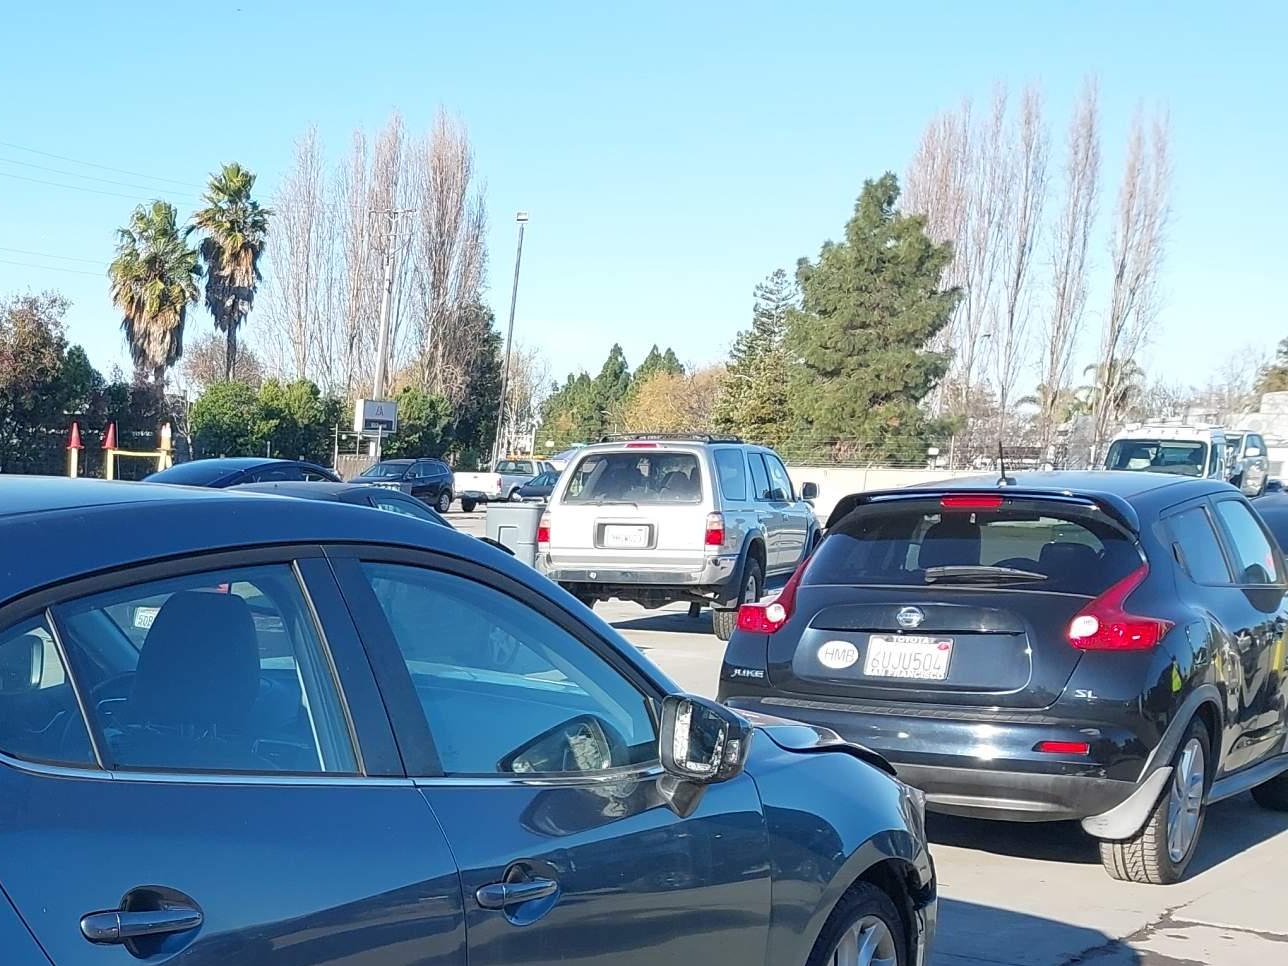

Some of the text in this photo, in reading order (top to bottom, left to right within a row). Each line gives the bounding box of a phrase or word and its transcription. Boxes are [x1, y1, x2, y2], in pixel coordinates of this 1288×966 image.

[824, 647, 855, 663] HMB
[870, 650, 943, 672] 6UJU504
[730, 669, 765, 678] JUKE
[1074, 689, 1098, 699] SL
